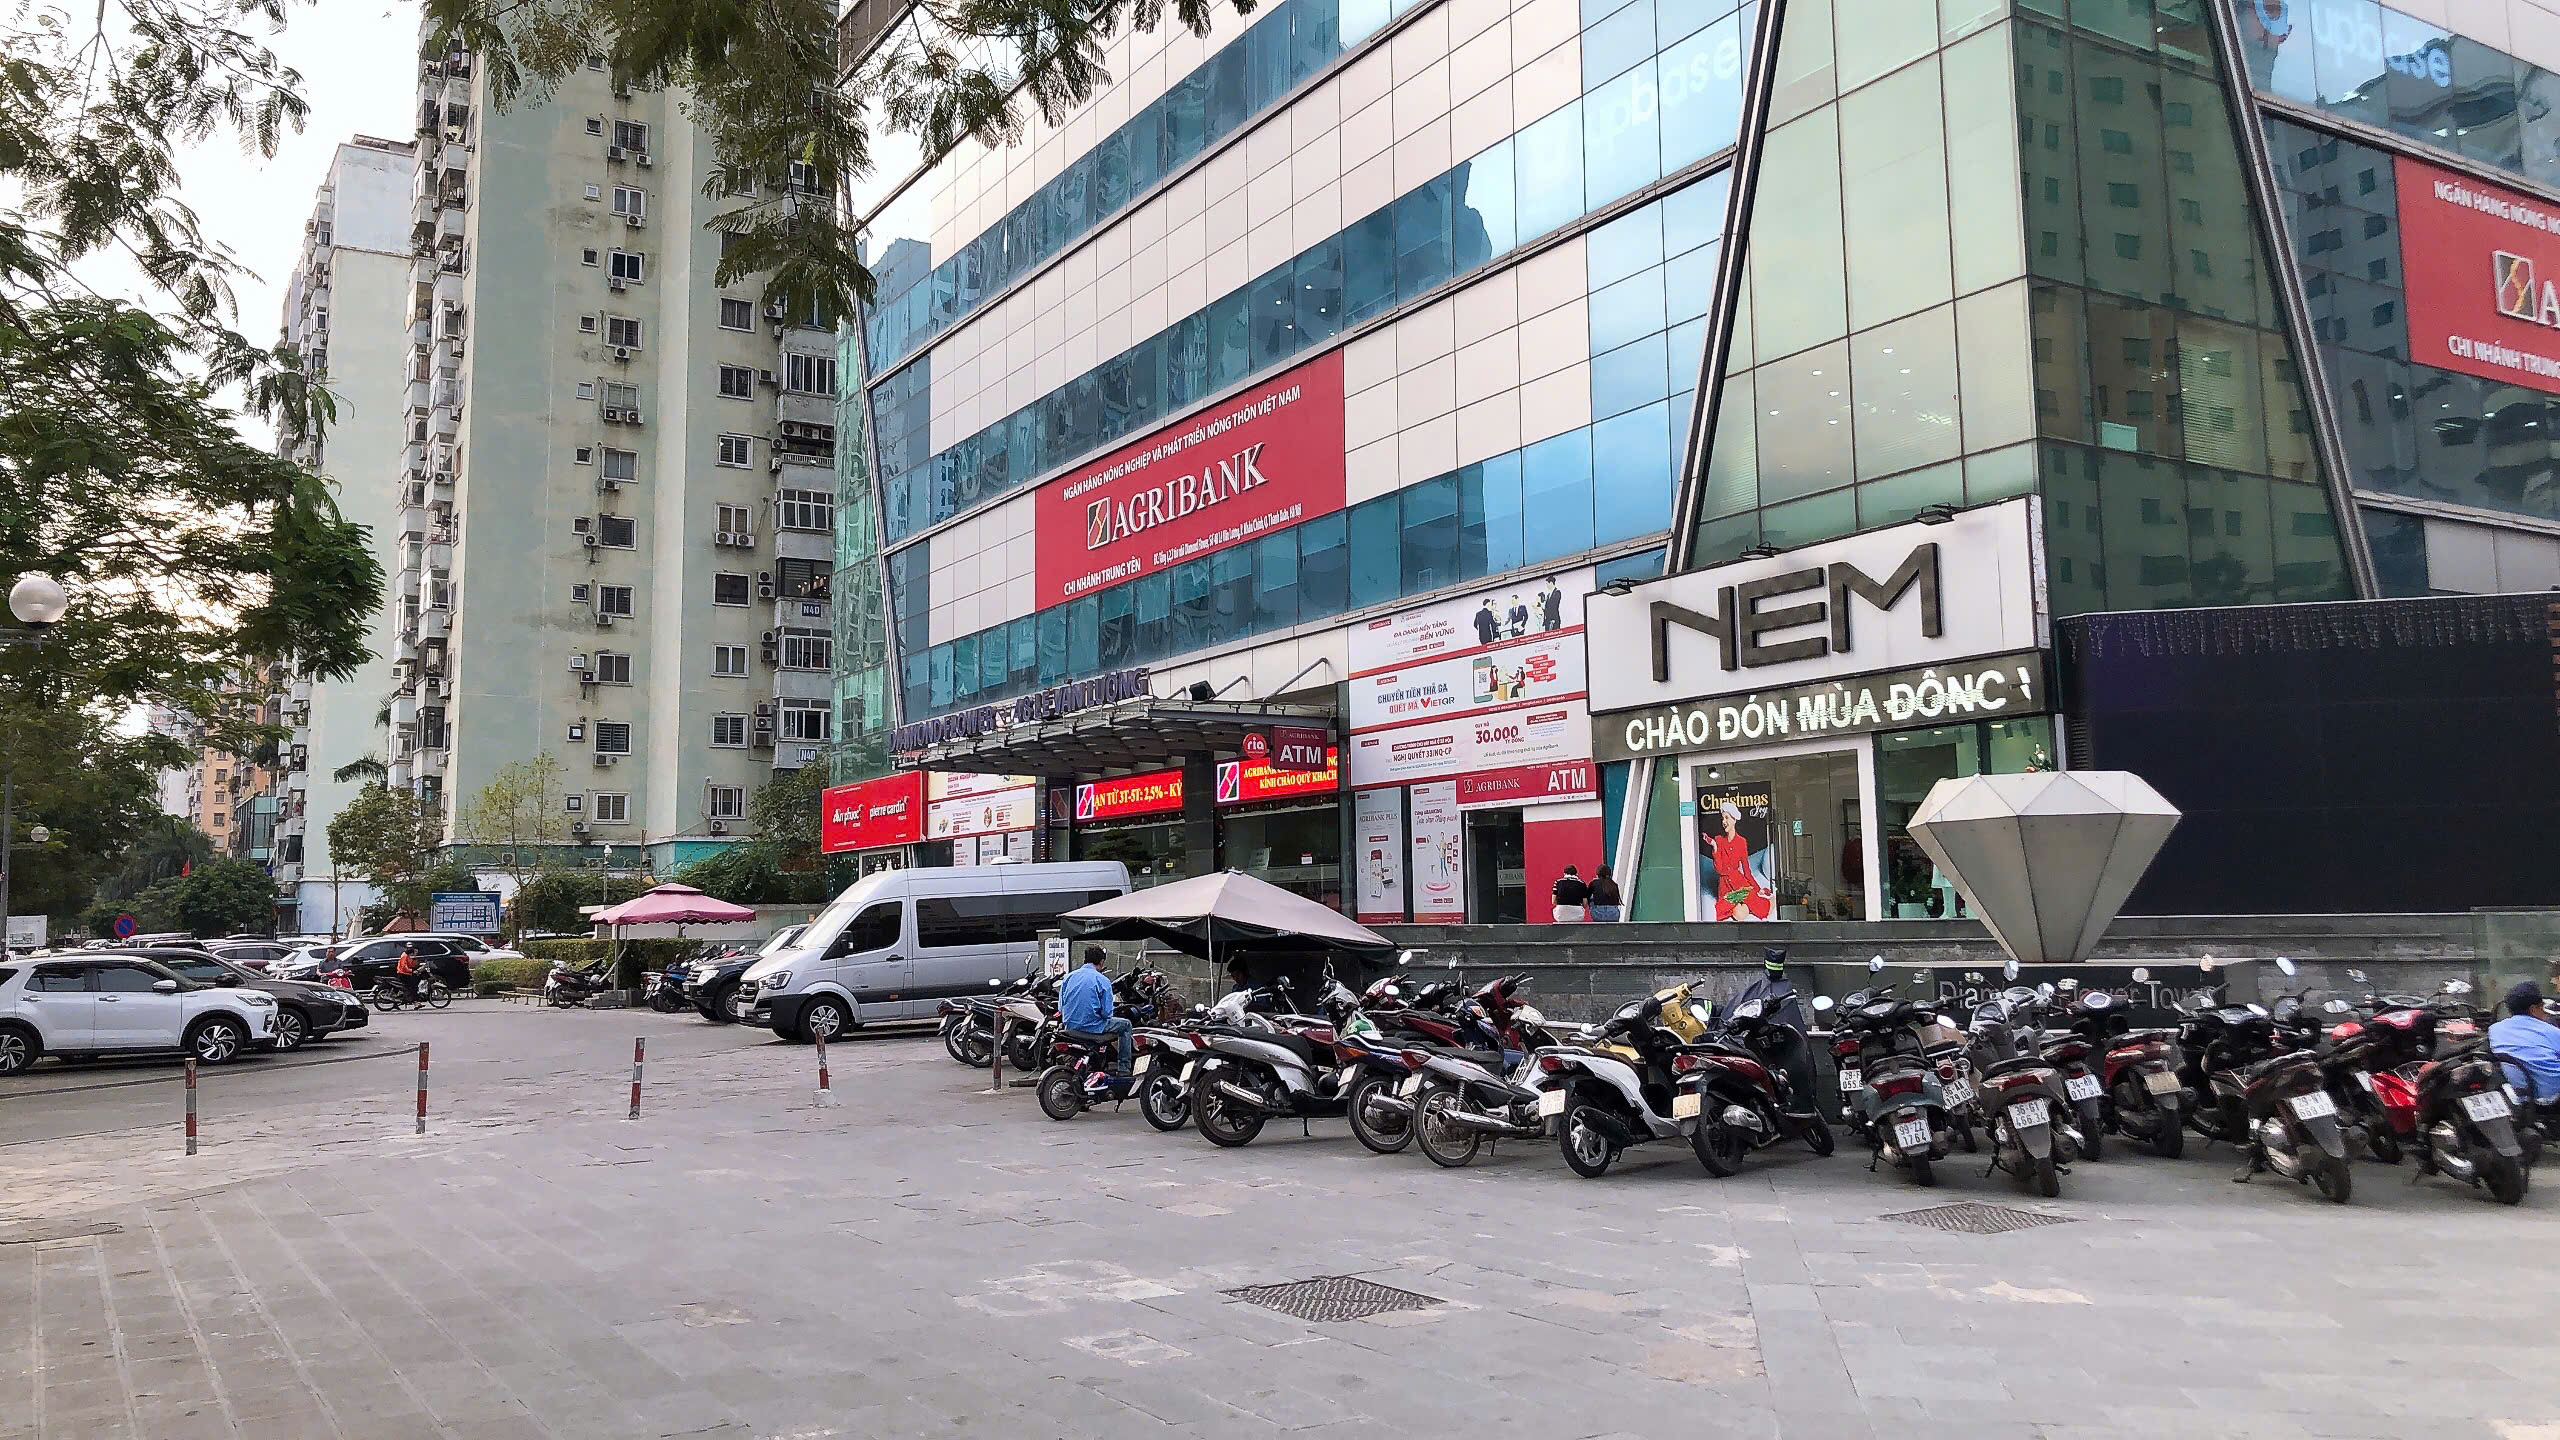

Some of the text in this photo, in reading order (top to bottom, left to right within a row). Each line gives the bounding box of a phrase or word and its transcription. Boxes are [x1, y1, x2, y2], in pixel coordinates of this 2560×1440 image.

[2448, 335, 2473, 358] CHI
[1063, 384, 1301, 501] NGÂN HÀNG NÔNG NGHIỆP VÀ PHÁT TRIỂN NÔNG THÔN VIỆT NAM
[1111, 442, 1269, 542] AGRIBANK
[1064, 555, 1141, 596] CHI NHÁNH TRUNG YÊN
[803, 604, 820, 616] N4D
[1650, 543, 1943, 682] NEM
[1405, 687, 1422, 700] TIỀN
[1437, 683, 1449, 693] GA
[1421, 696, 1455, 708] VIETQR
[1625, 706, 1710, 752] CHÀO
[1717, 698, 1789, 741] ĐÓN
[1796, 681, 1881, 732] MÙA
[889, 705, 996, 752] DIAMOND FLOWER
[1475, 725, 1518, 744] 30.000
[1247, 736, 1265, 750] ria
[800, 749, 816, 761] N4D
[1280, 744, 1322, 764] ATM
[1393, 753, 1407, 763] NGHỊ
[1408, 749, 1425, 760] QUYẾT
[1260, 776, 1276, 789] KÍNH
[1276, 771, 1295, 787] CHÀO
[1476, 768, 1587, 792] AGRIBANK ATM
[1107, 787, 1119, 805] TỪ
[1119, 788, 1143, 804] 3T-5T:
[1144, 785, 1163, 803] 2,5%
[1701, 792, 1768, 810] Christmas
[870, 800, 905, 820] pierre cardin
[1750, 804, 1768, 818] Joy
[1903, 1130, 1927, 1146] 1764
